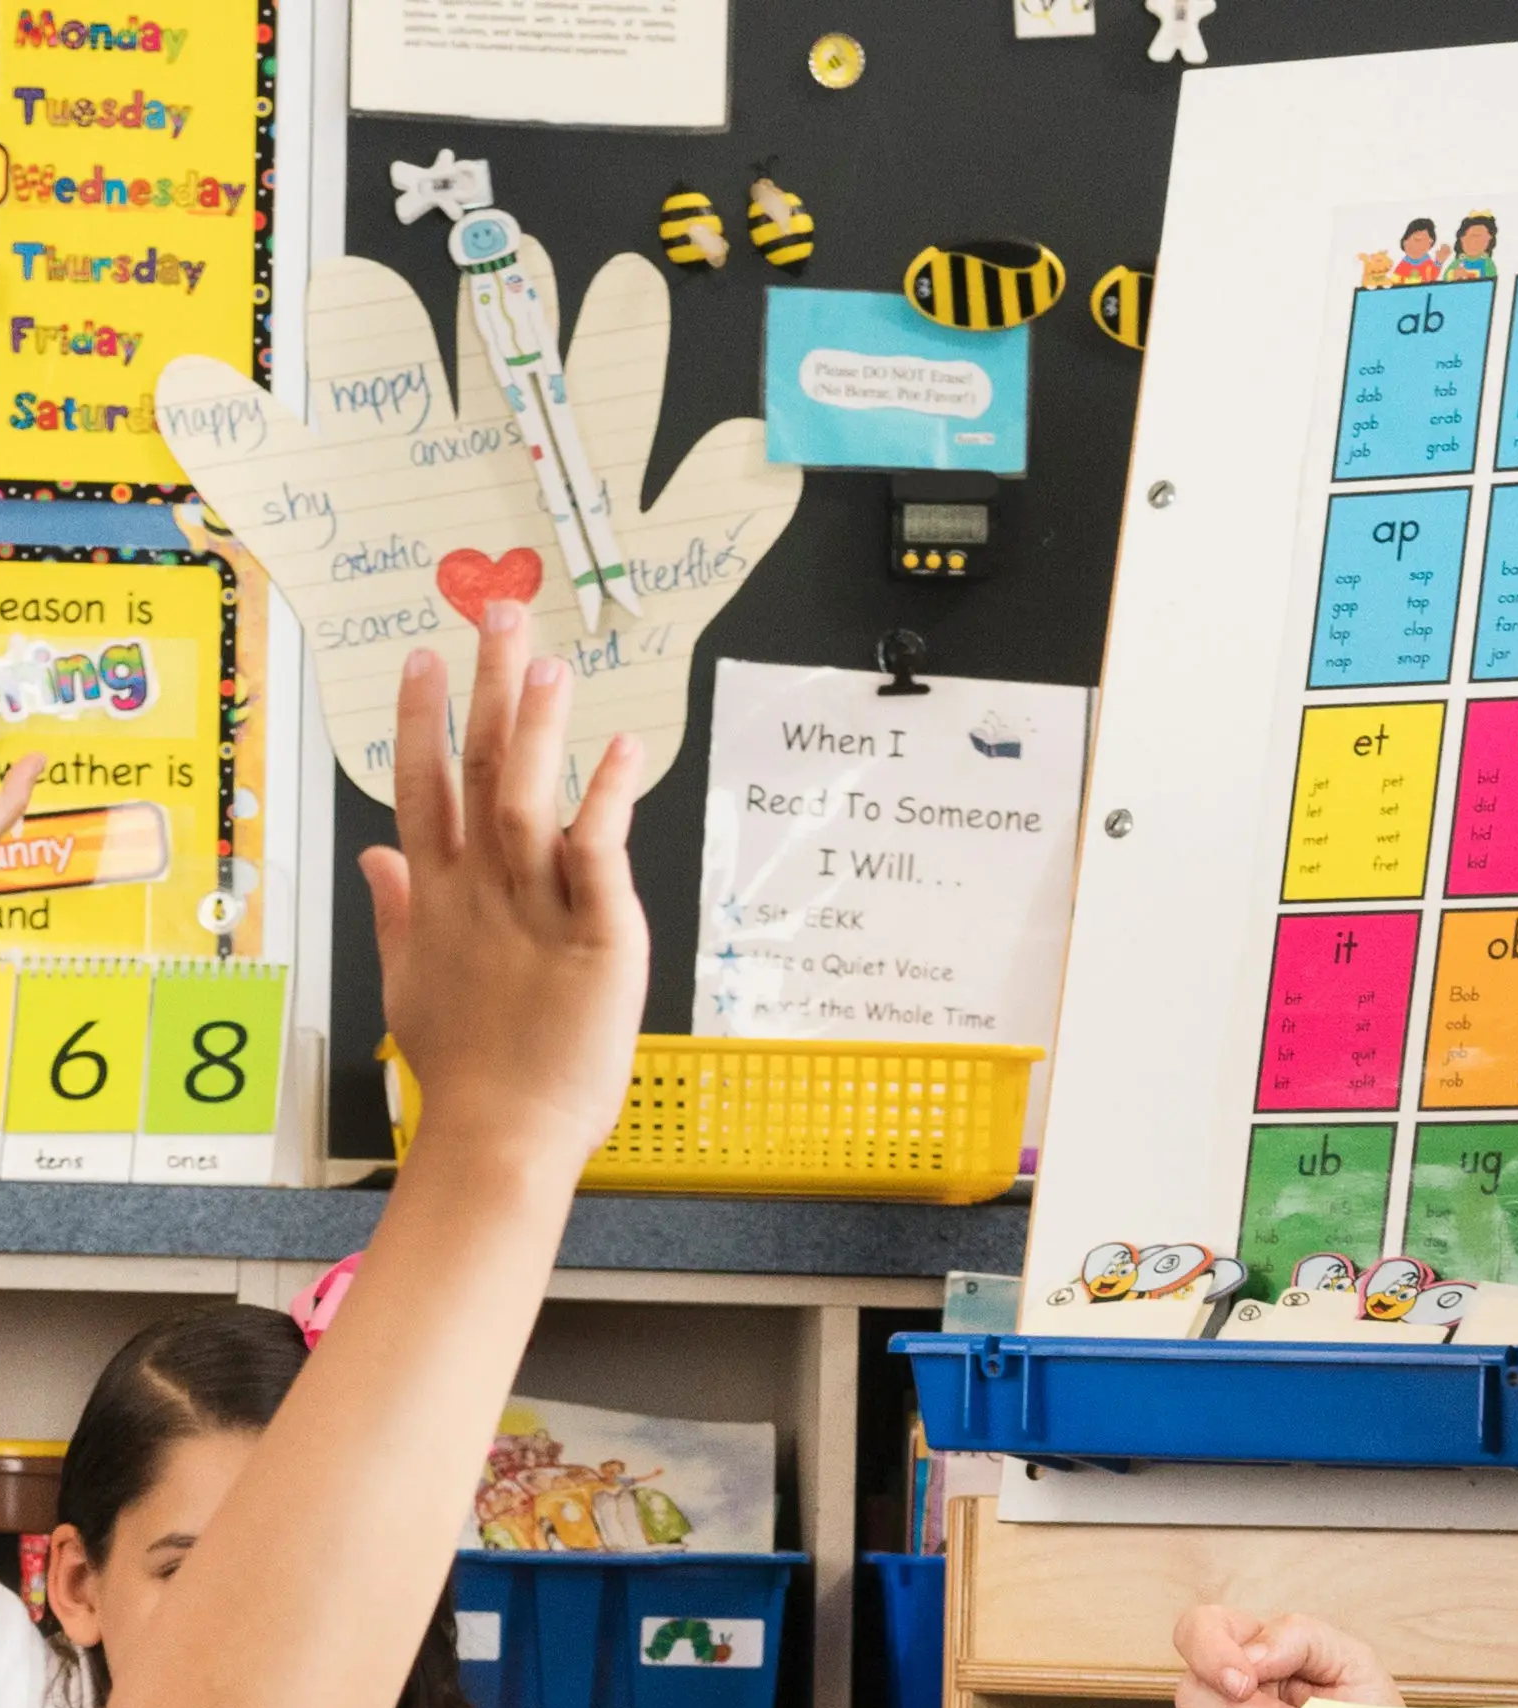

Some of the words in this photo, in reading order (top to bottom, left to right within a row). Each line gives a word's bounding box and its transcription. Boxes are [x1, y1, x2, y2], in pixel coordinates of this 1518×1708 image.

[14, 9, 188, 64] Monday
[13, 87, 193, 140] Tuesday
[11, 162, 247, 217] Wednesday
[12, 241, 206, 295] Thursday
[1397, 293, 1444, 335] ab
[9, 316, 143, 367] Friday
[814, 362, 859, 378] Please
[863, 366, 888, 380] DO
[892, 367, 926, 383] NOT
[1359, 361, 1384, 375] cab
[1436, 354, 1462, 369] nab
[331, 360, 432, 437] happy
[1356, 387, 1382, 403] dab
[1434, 381, 1457, 397] tab
[9, 392, 161, 434] Saturd
[164, 396, 268, 453] happy
[1353, 414, 1379, 438] gab
[1430, 409, 1462, 425] crab
[408, 418, 522, 469] anxious
[1345, 443, 1371, 465] jab
[1426, 436, 1459, 460] grab
[261, 481, 338, 550] shy
[1372, 520, 1419, 561] ap
[630, 536, 747, 597] tterflies
[1410, 571, 1433, 586] sap
[127, 592, 155, 626] is
[1407, 597, 1429, 613] tap
[317, 595, 441, 651] scared
[1496, 616, 1518, 632] far
[1398, 654, 1430, 668] snap
[782, 720, 876, 758] When
[888, 730, 908, 759] I
[1353, 724, 1389, 756] et
[168, 754, 195, 788] is
[746, 784, 828, 818] Read
[844, 791, 882, 821] To
[893, 796, 1044, 834] Someone
[817, 848, 837, 878] I
[1373, 856, 1399, 870] fret
[755, 903, 789, 925] Sit
[1335, 932, 1358, 963] it
[802, 957, 815, 972] a
[822, 954, 887, 979] Quiet
[895, 958, 955, 983] Voice
[1450, 986, 1480, 1002] Bob
[819, 1000, 857, 1020] the
[866, 1003, 934, 1027] Whole
[944, 1005, 997, 1030] Time
[49, 1020, 109, 1102] 6
[183, 1020, 250, 1104] 8
[35, 1149, 85, 1170] tens
[166, 1153, 219, 1170] ones
[1297, 1133, 1343, 1178] ub
[1460, 1149, 1503, 1194] ug
